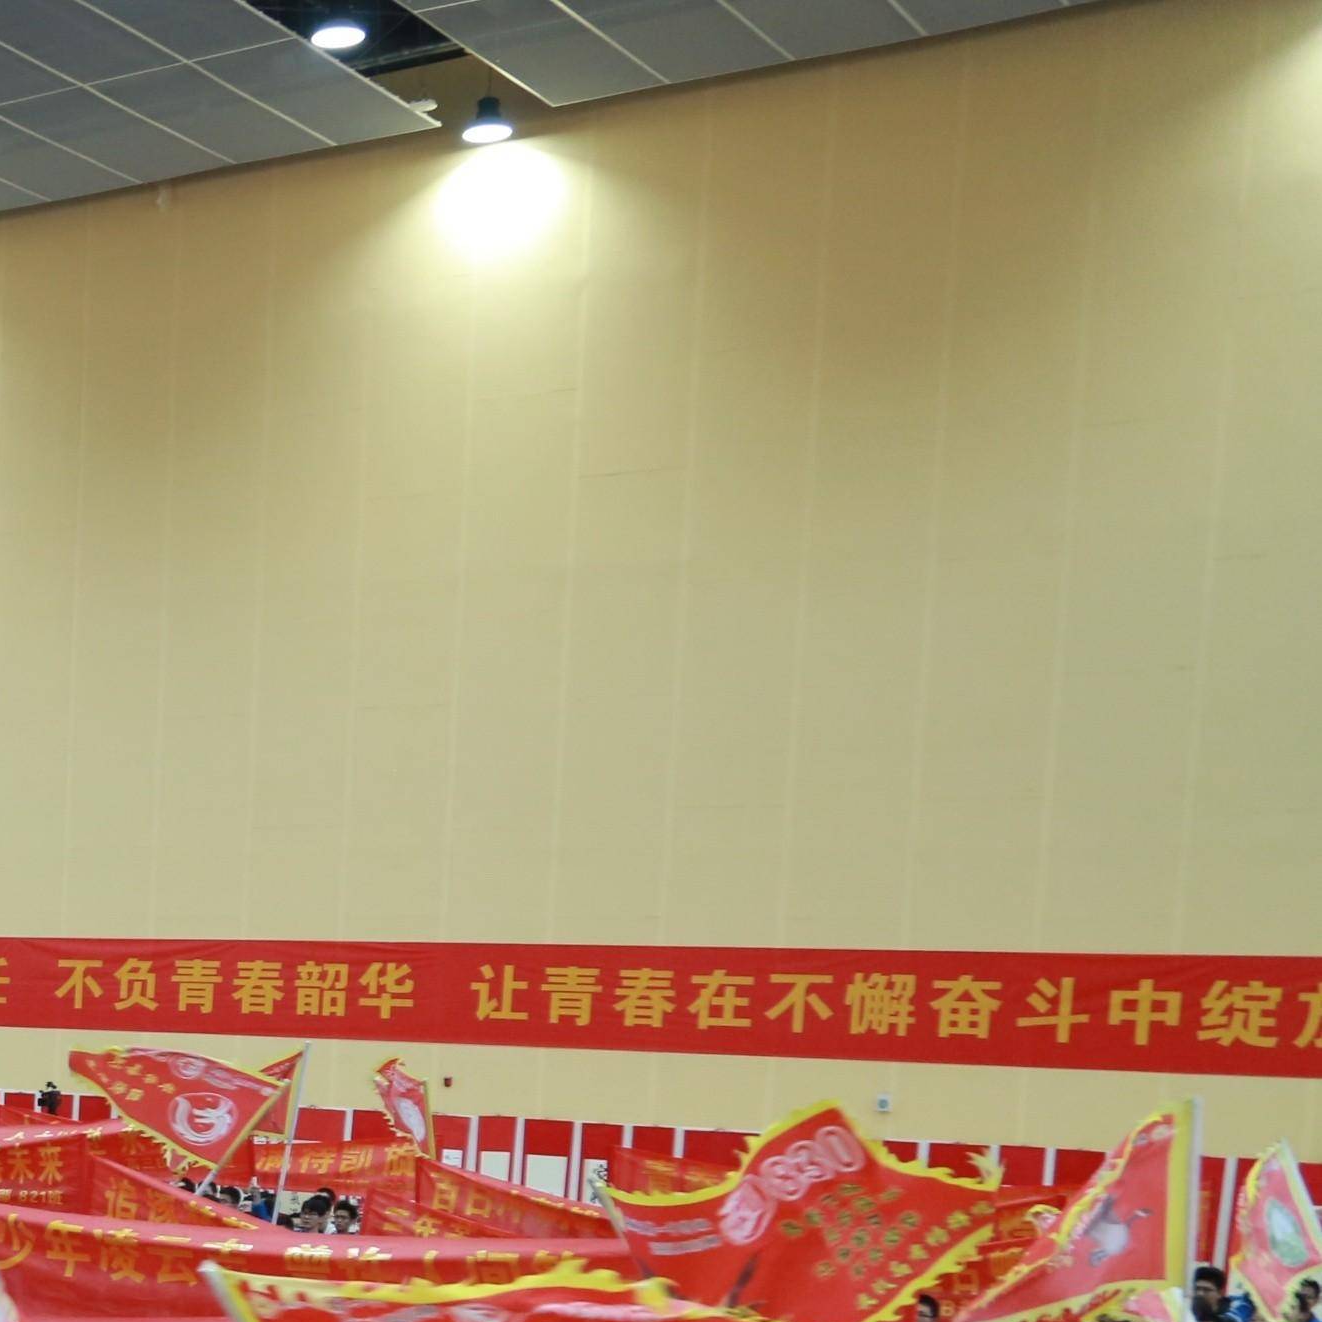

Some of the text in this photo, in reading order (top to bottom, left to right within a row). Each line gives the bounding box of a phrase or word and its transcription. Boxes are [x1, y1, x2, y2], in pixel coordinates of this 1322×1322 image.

[54, 957, 415, 1020] 不负青春韶华
